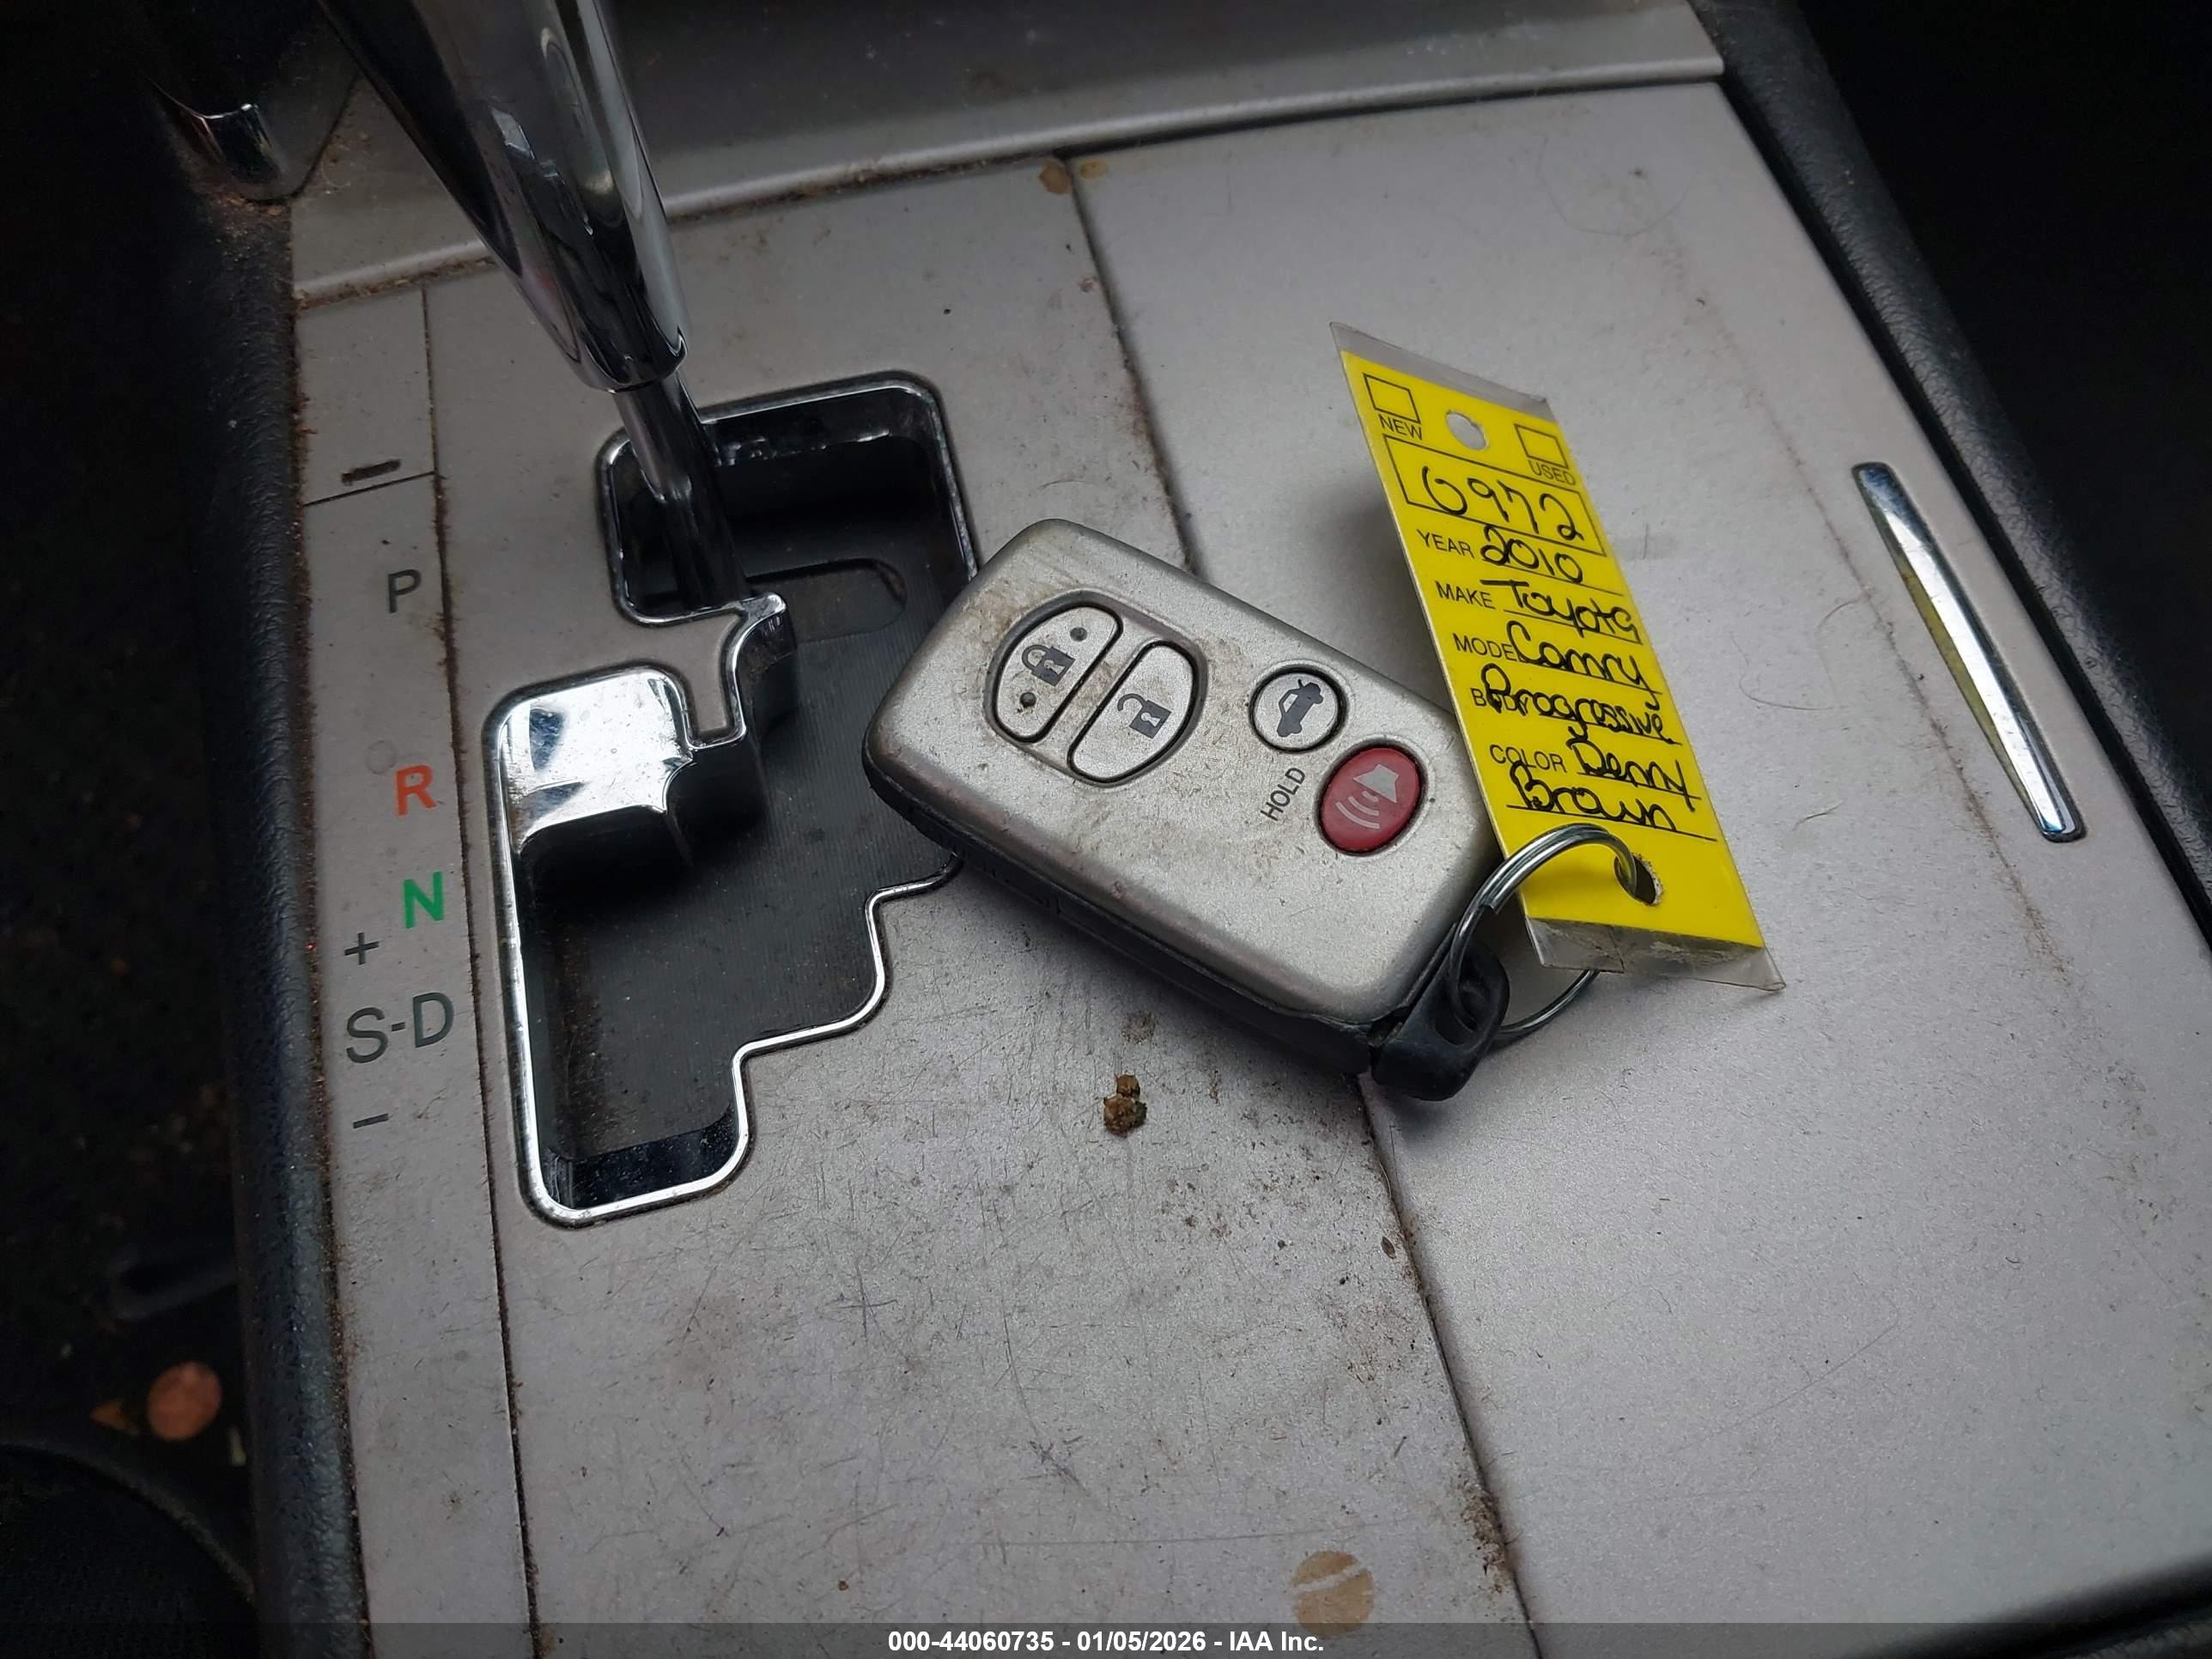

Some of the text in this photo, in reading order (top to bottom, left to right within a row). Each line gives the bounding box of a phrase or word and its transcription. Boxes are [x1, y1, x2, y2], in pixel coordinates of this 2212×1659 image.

[1379, 415, 1423, 441] NEW
[1528, 460, 1576, 486] USED
[1417, 529, 1475, 559] YEAR
[1480, 525, 1583, 584] 2010
[388, 568, 422, 614] P
[1435, 580, 1496, 610] MAKE
[1480, 580, 1641, 644] Toyota
[1453, 633, 1528, 663] MODE
[1507, 620, 1660, 711] Camry
[1490, 744, 1567, 773] COLOR
[396, 765, 434, 815] R
[1261, 768, 1305, 821] HOLD
[403, 872, 442, 927] N
